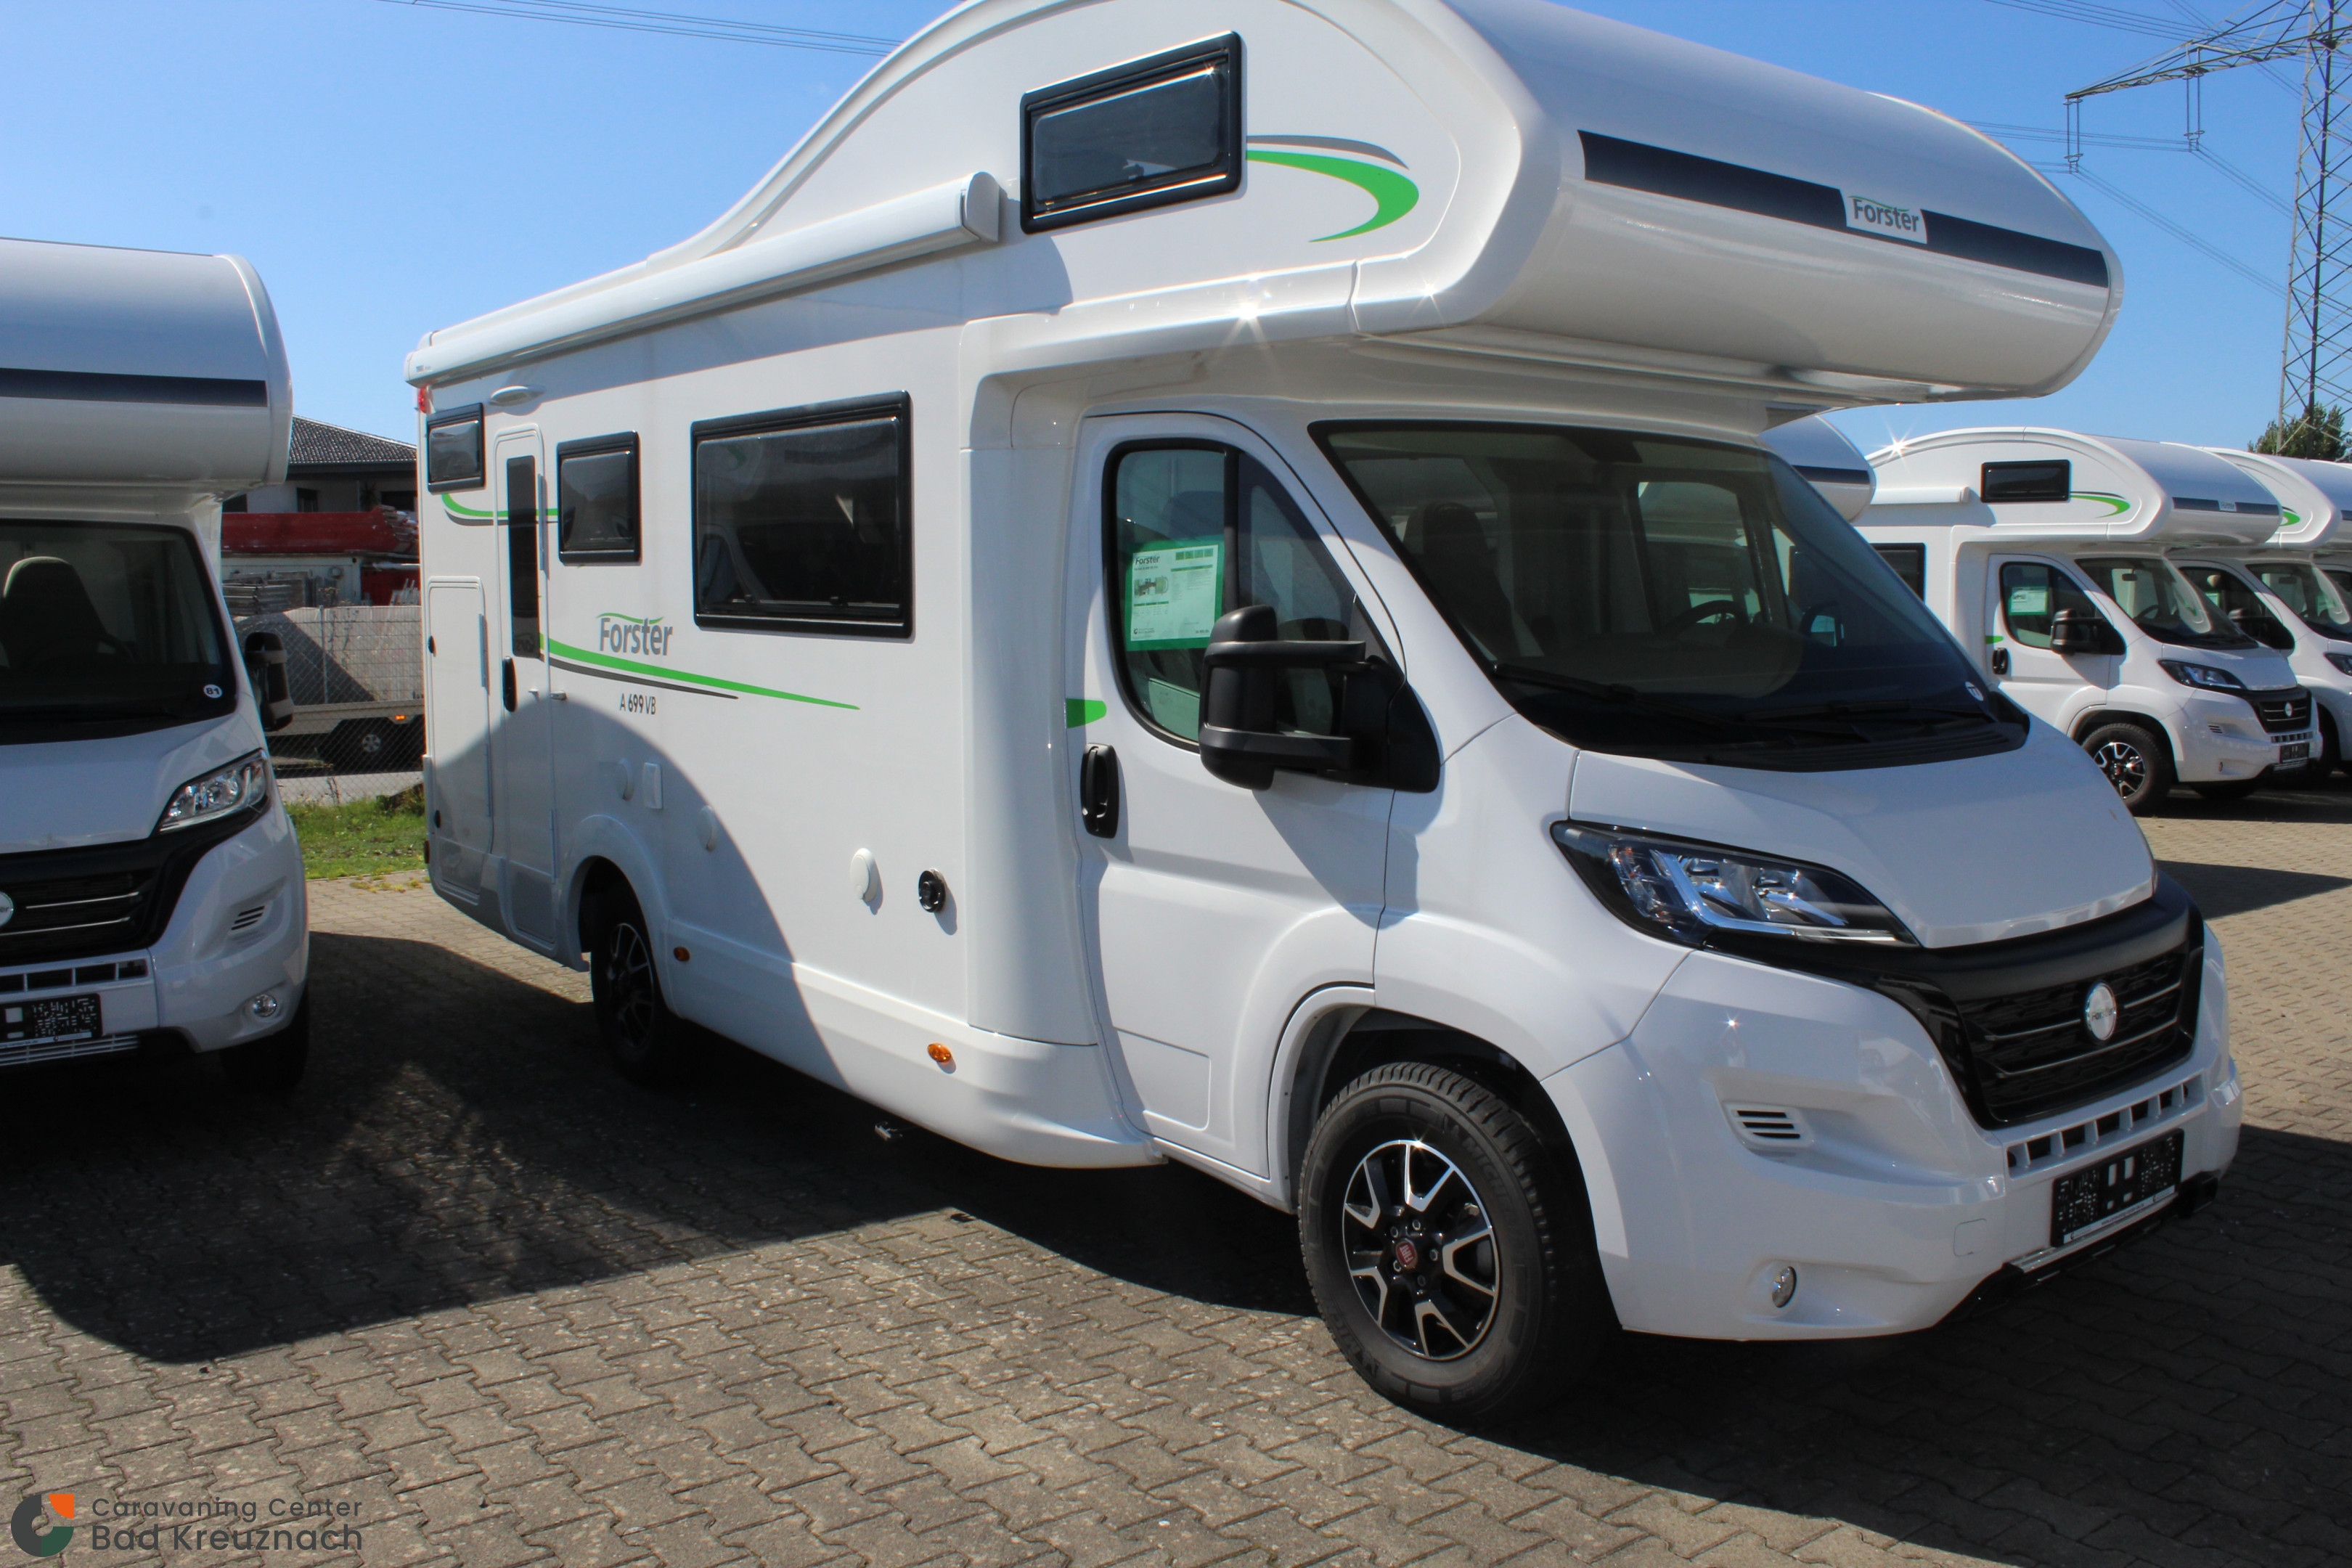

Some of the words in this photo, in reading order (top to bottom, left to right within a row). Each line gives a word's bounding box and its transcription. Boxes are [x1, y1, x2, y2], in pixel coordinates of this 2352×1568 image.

[1853, 198, 1919, 232] Forster
[1135, 556, 1160, 565] Forster
[600, 617, 674, 656] Forster
[619, 693, 626, 711] A
[628, 693, 645, 714] 699
[645, 695, 657, 715] VB
